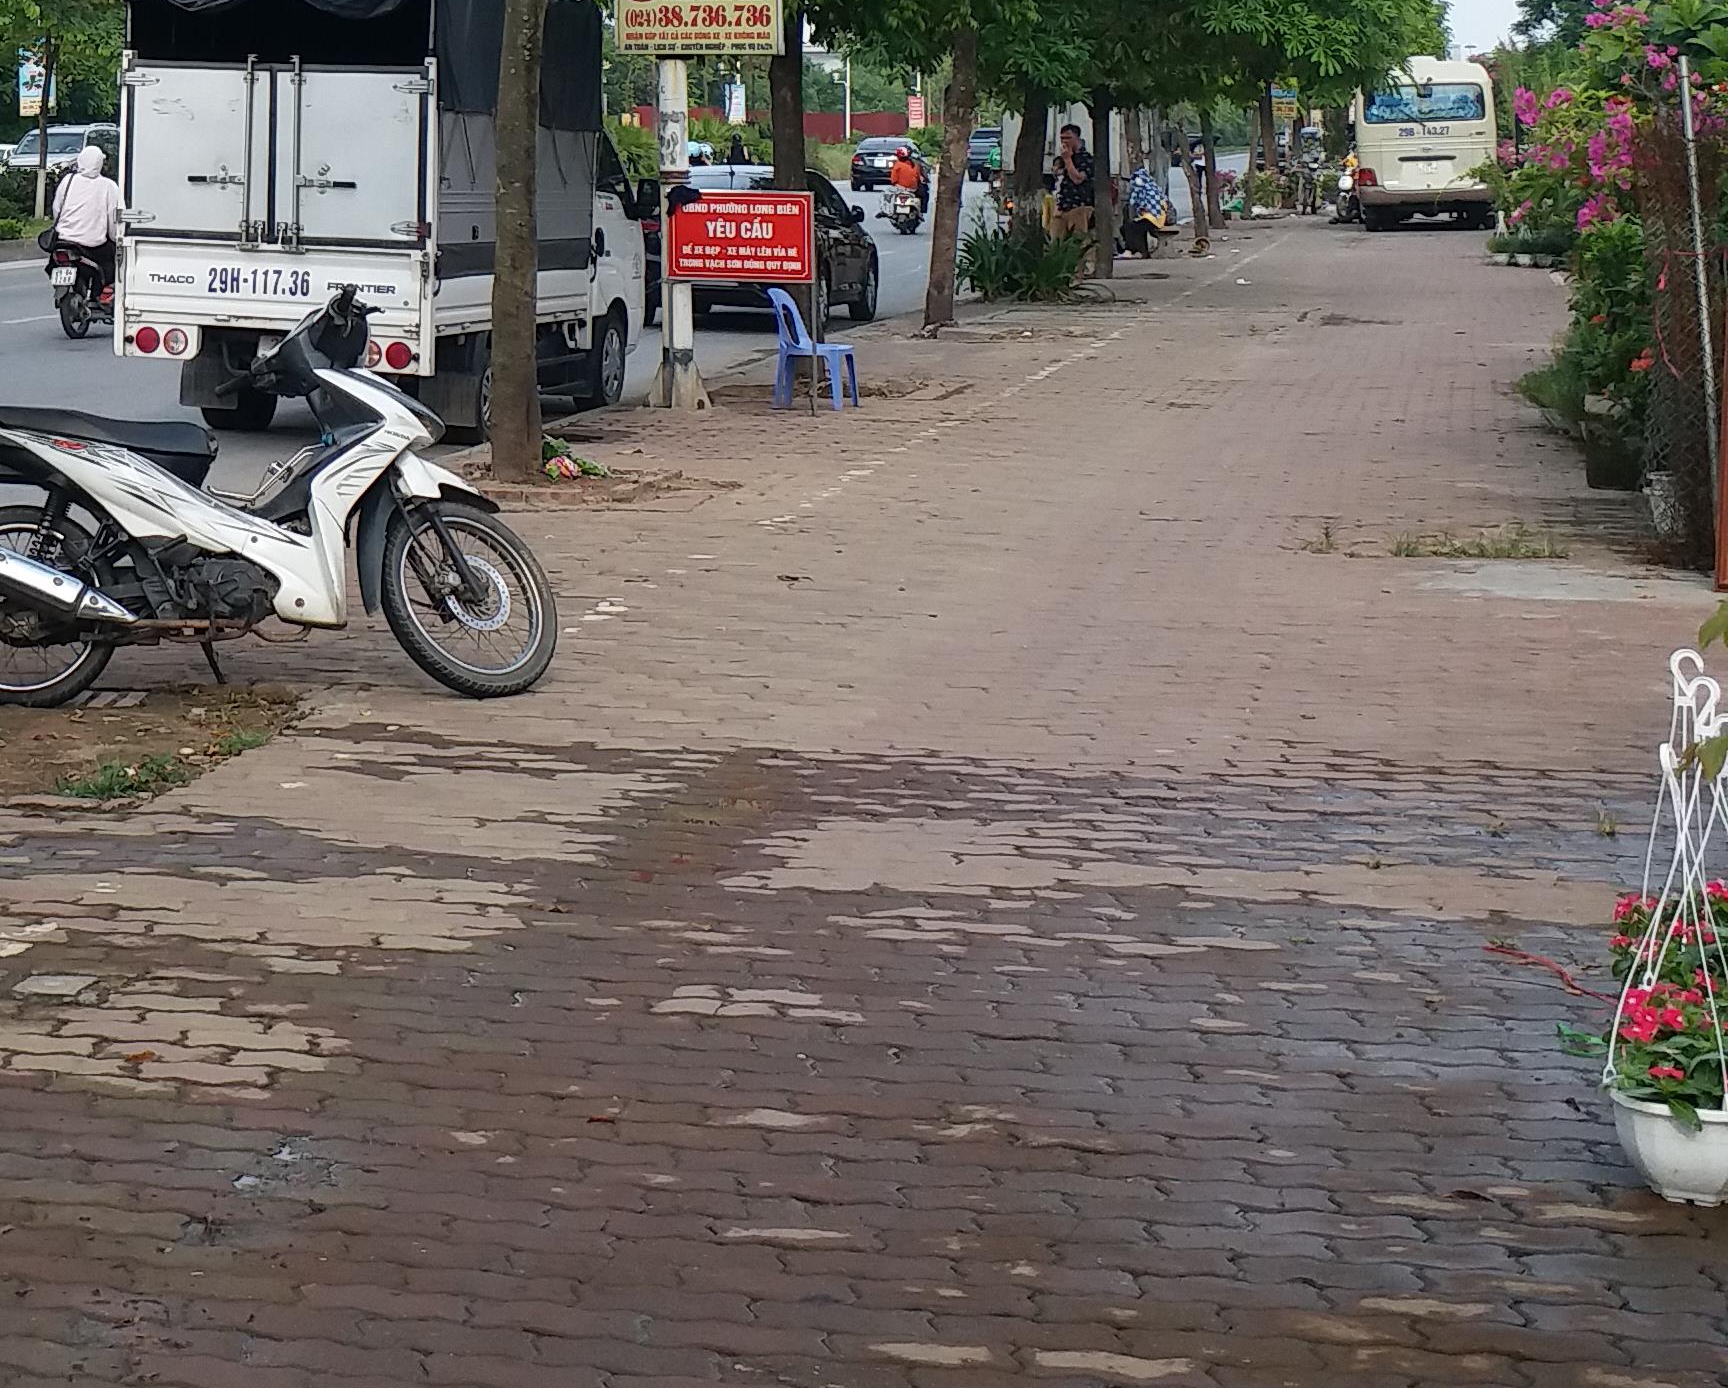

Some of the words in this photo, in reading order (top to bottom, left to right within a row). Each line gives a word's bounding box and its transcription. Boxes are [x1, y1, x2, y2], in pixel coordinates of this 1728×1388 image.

[682, 202, 708, 213] UBND
[710, 201, 748, 214] PHƯỜNG
[750, 204, 775, 215] LONG
[776, 202, 800, 215] BIÊN
[706, 217, 736, 238] YÊU
[694, 245, 704, 255] XE
[727, 246, 738, 256] XE
[738, 245, 755, 256] MÁY
[757, 245, 772, 257] LÊN
[149, 273, 195, 285] THACO
[207, 267, 311, 297] 29H-117.36
[327, 281, 396, 295] FRNTIER
